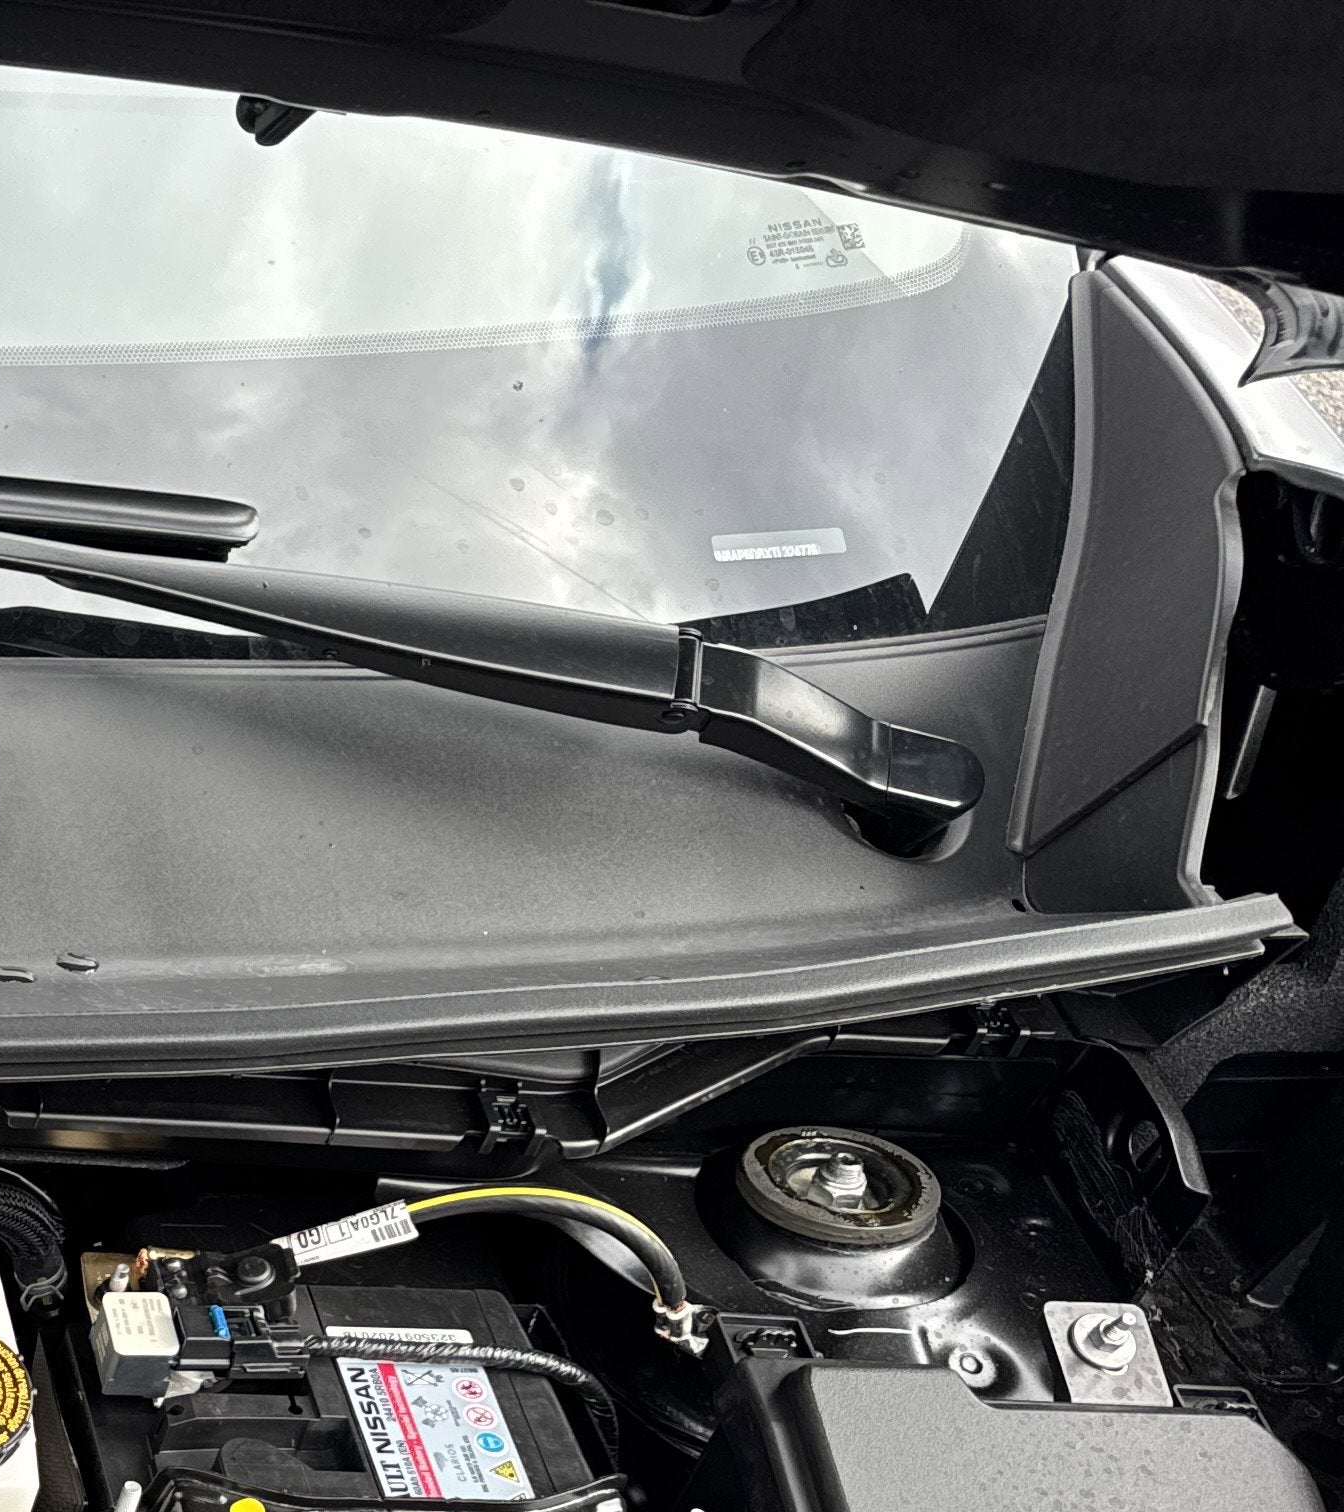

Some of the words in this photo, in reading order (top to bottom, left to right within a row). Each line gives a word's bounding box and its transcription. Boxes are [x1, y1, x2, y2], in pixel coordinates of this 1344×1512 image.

[767, 218, 822, 233] NISSAN
[347, 1366, 395, 1454] NISSAN
[445, 1443, 468, 1483] CLARIOS
